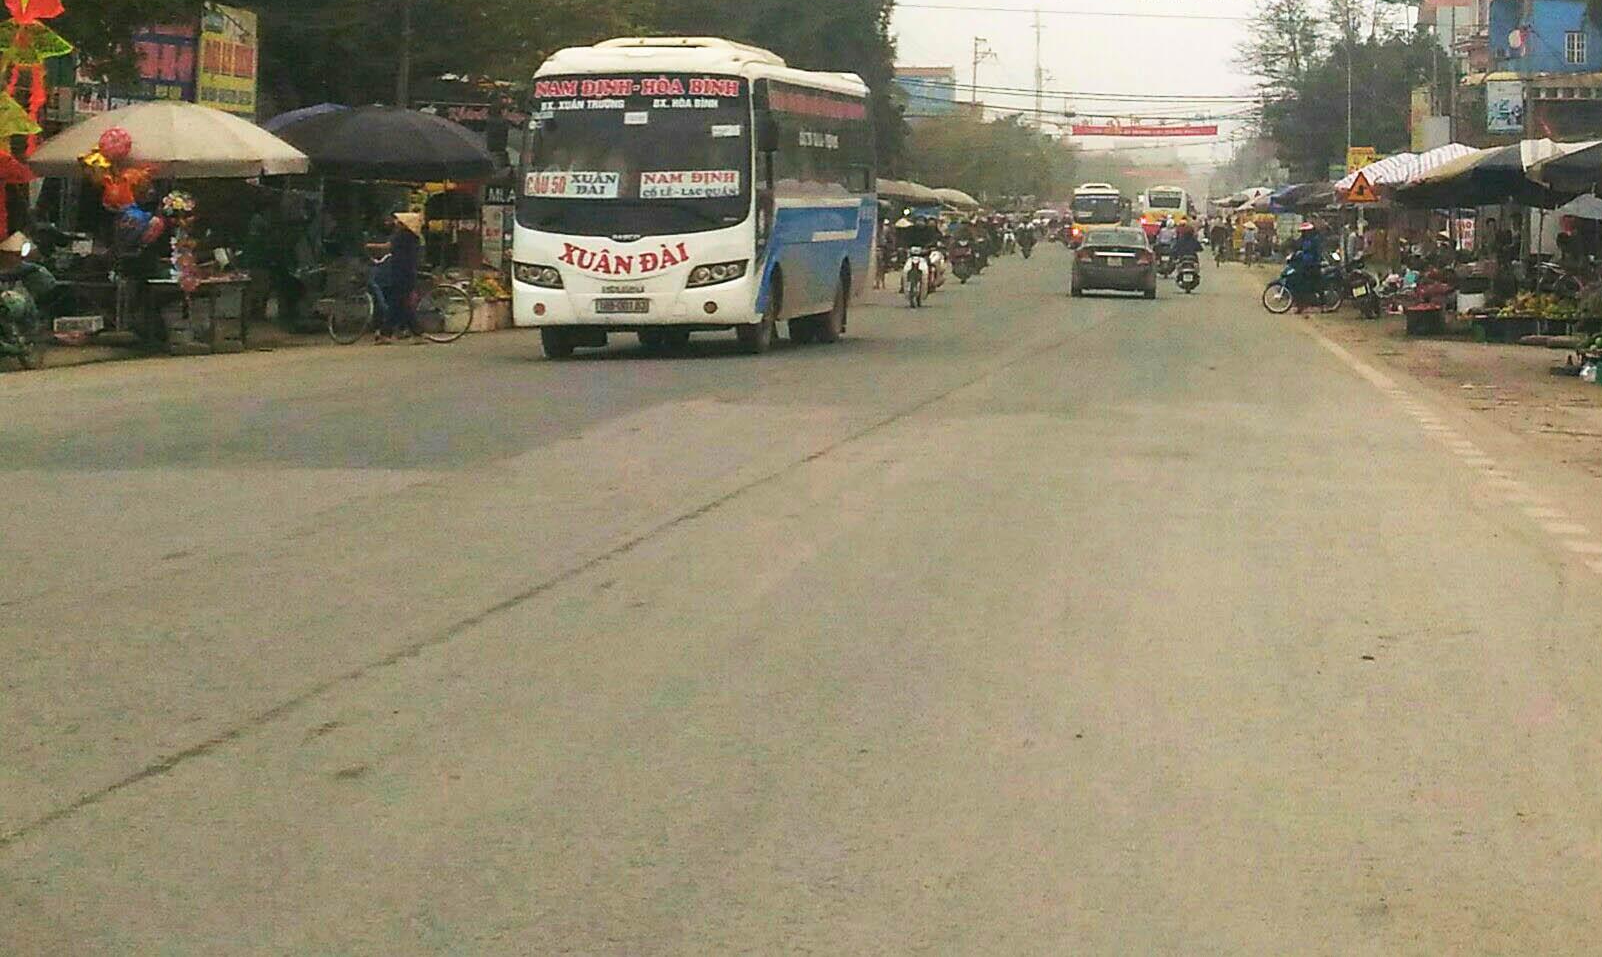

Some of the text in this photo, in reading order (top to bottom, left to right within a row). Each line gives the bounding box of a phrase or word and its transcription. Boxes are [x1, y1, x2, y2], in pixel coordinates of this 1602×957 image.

[535, 79, 578, 97] NAM
[643, 174, 682, 185] NAM
[558, 243, 689, 275] XUÂN ĐÀI
